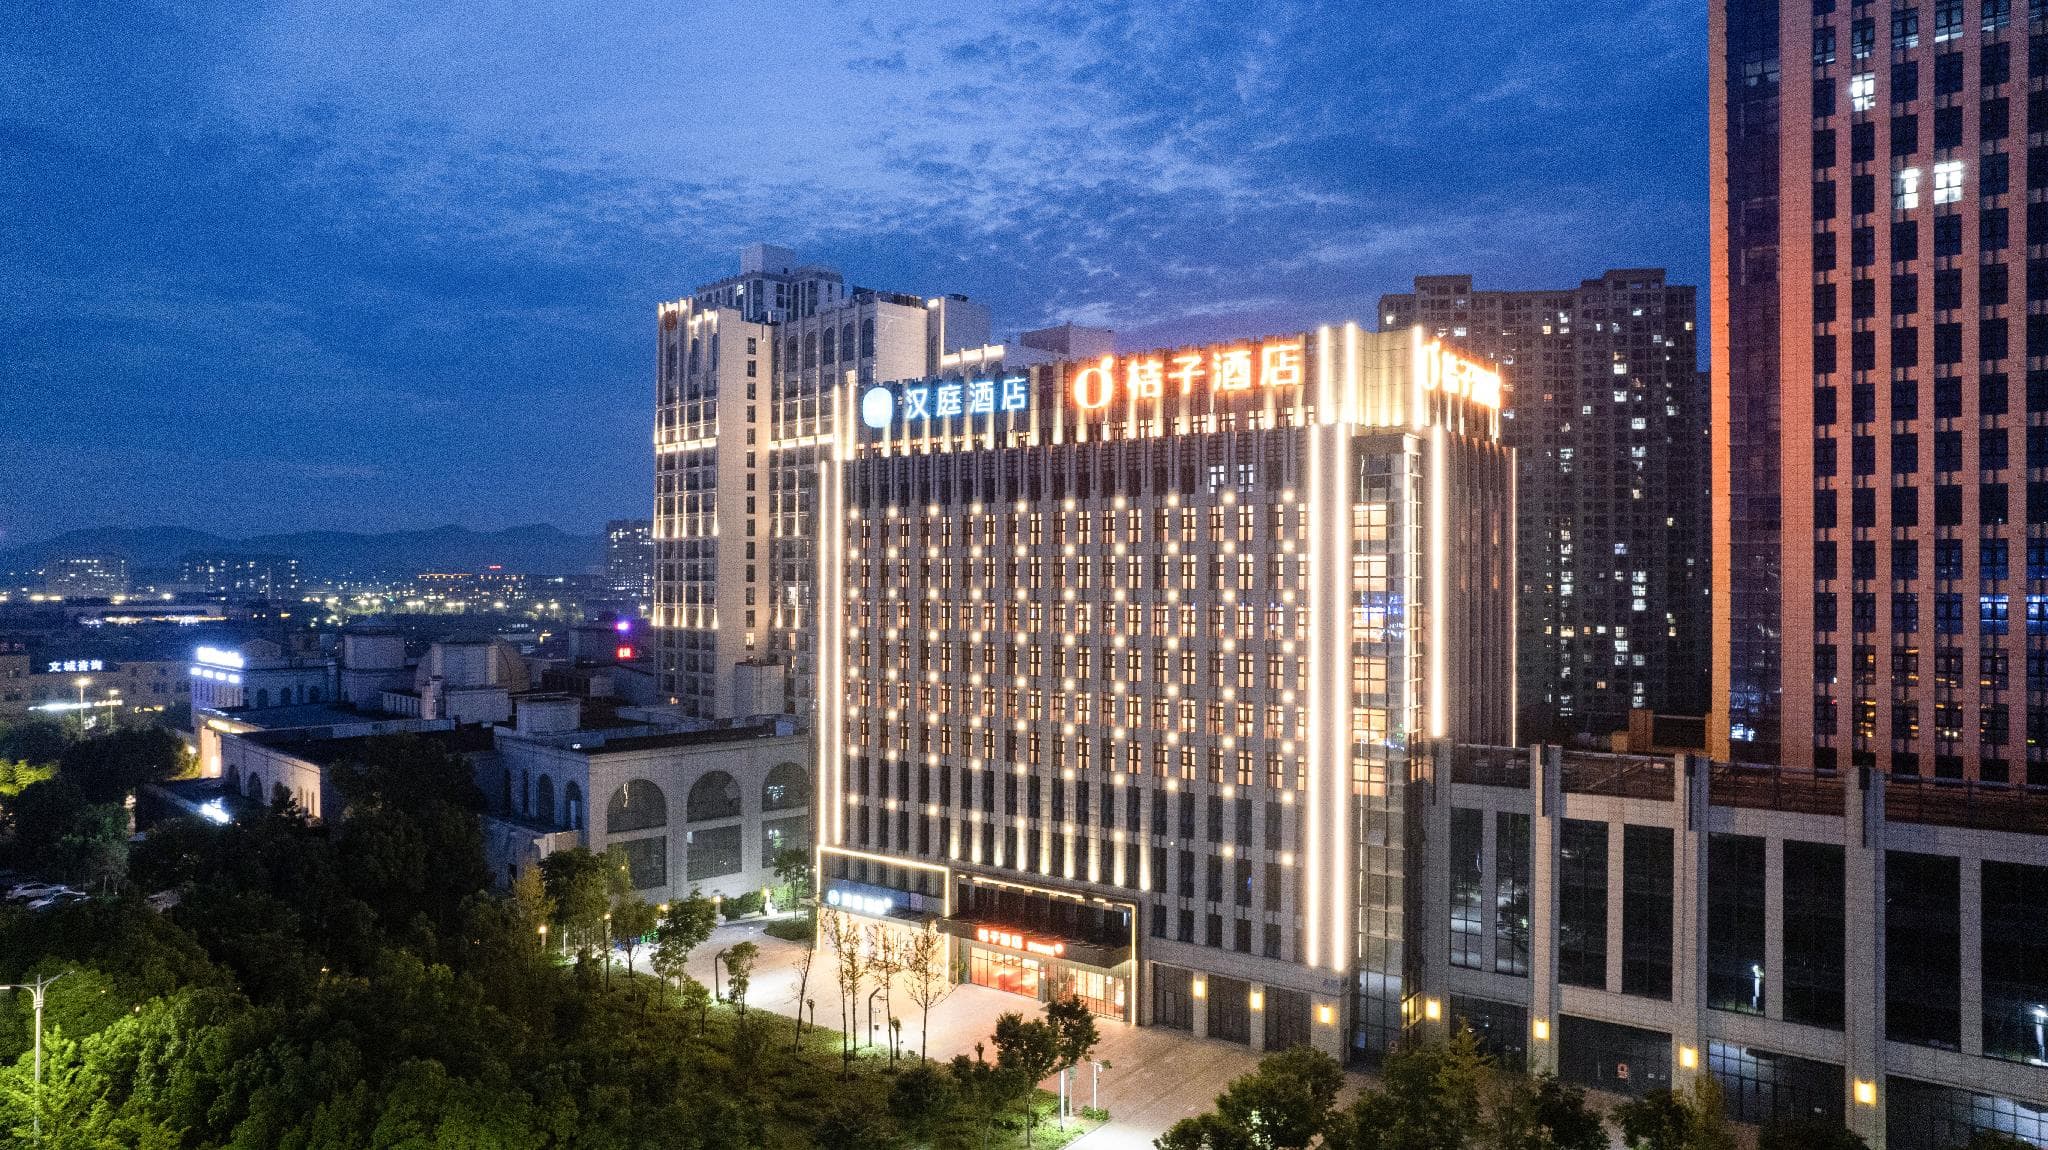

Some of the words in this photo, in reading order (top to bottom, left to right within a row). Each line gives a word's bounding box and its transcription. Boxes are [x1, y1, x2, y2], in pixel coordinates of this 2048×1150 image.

[1127, 345, 1300, 400] 桔子酒店
[905, 376, 1026, 419] 汉庭酒店
